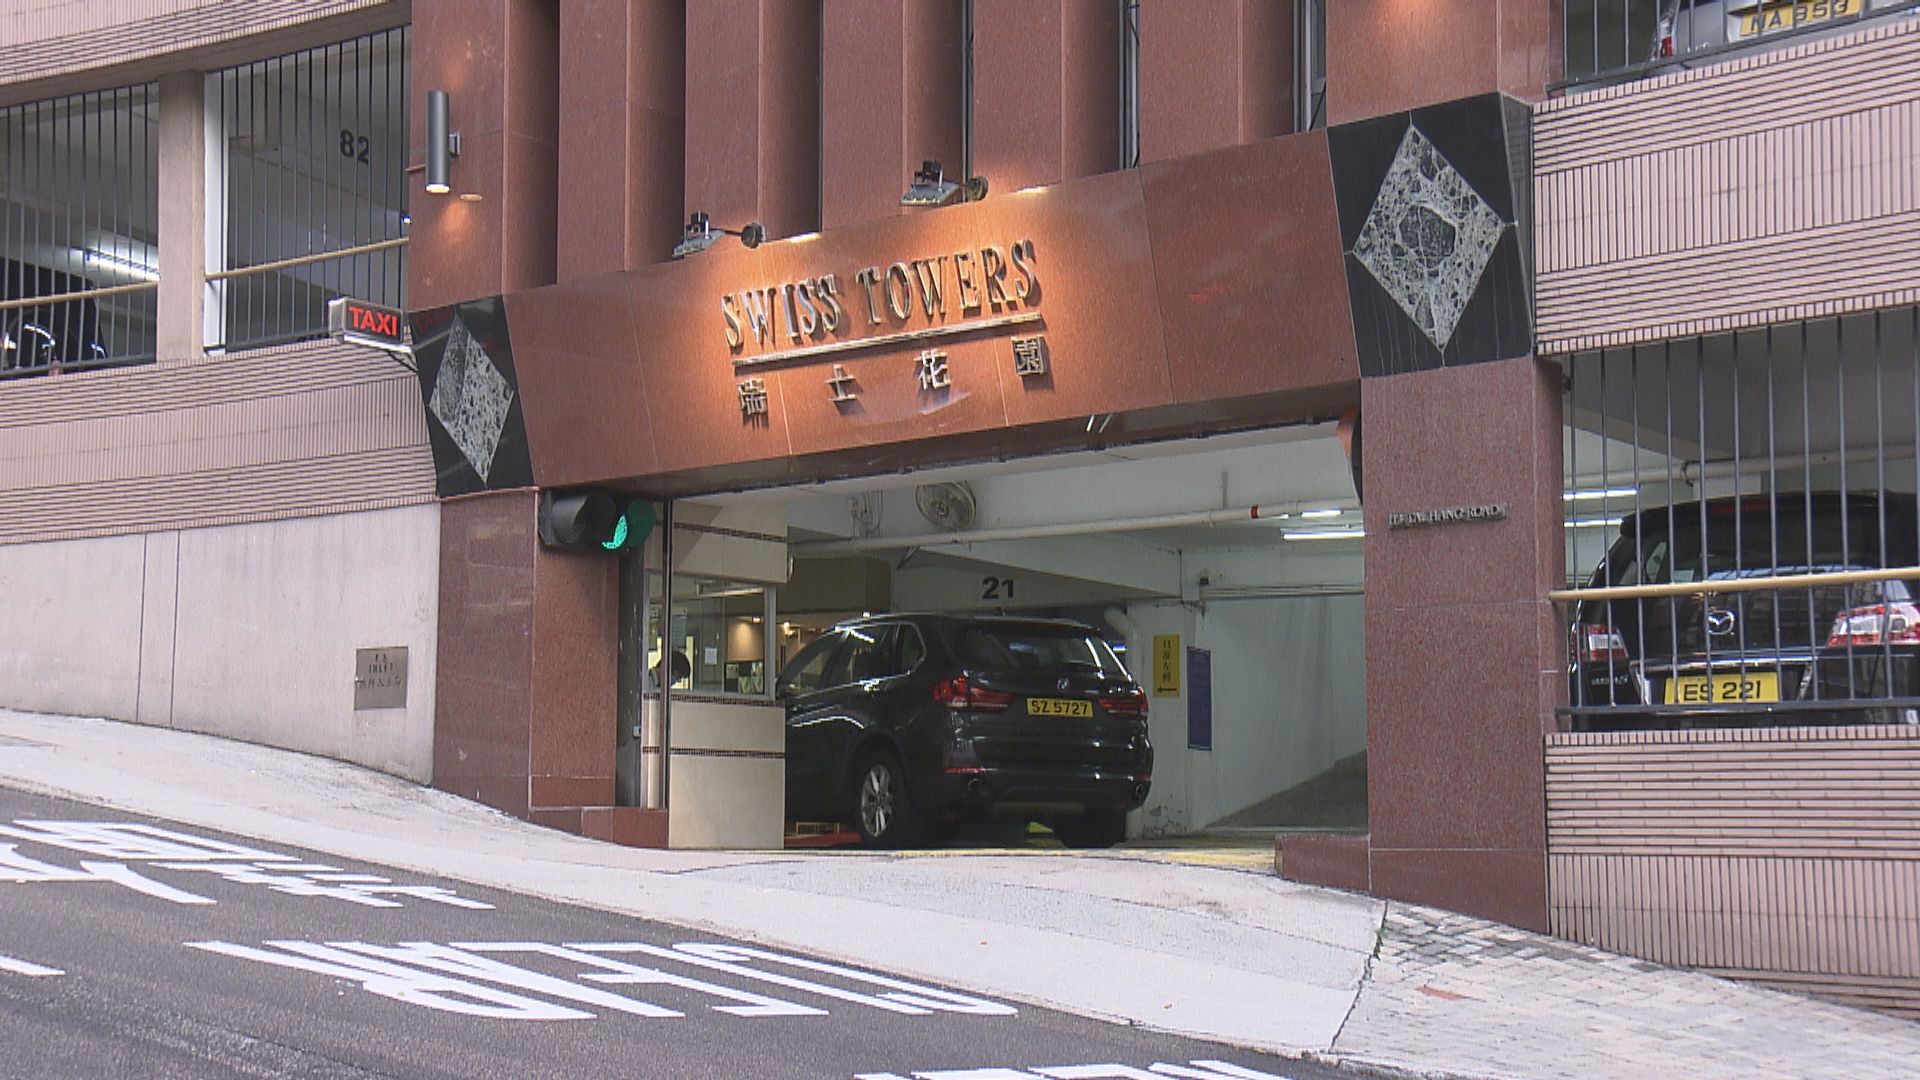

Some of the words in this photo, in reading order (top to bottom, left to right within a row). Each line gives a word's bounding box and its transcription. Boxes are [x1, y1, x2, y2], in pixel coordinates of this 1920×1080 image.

[340, 129, 369, 166] 82
[720, 273, 843, 349] SWISS
[855, 239, 1041, 326] TOWERS
[349, 306, 398, 337] TAXI
[737, 335, 1046, 416] 瑞士花園
[1467, 504, 1503, 519] ROAD
[982, 576, 1014, 600] 21
[1684, 684, 1714, 701] ES
[1722, 680, 1762, 700] 221
[1031, 700, 1050, 713] SZ
[1053, 701, 1088, 716] 5727
